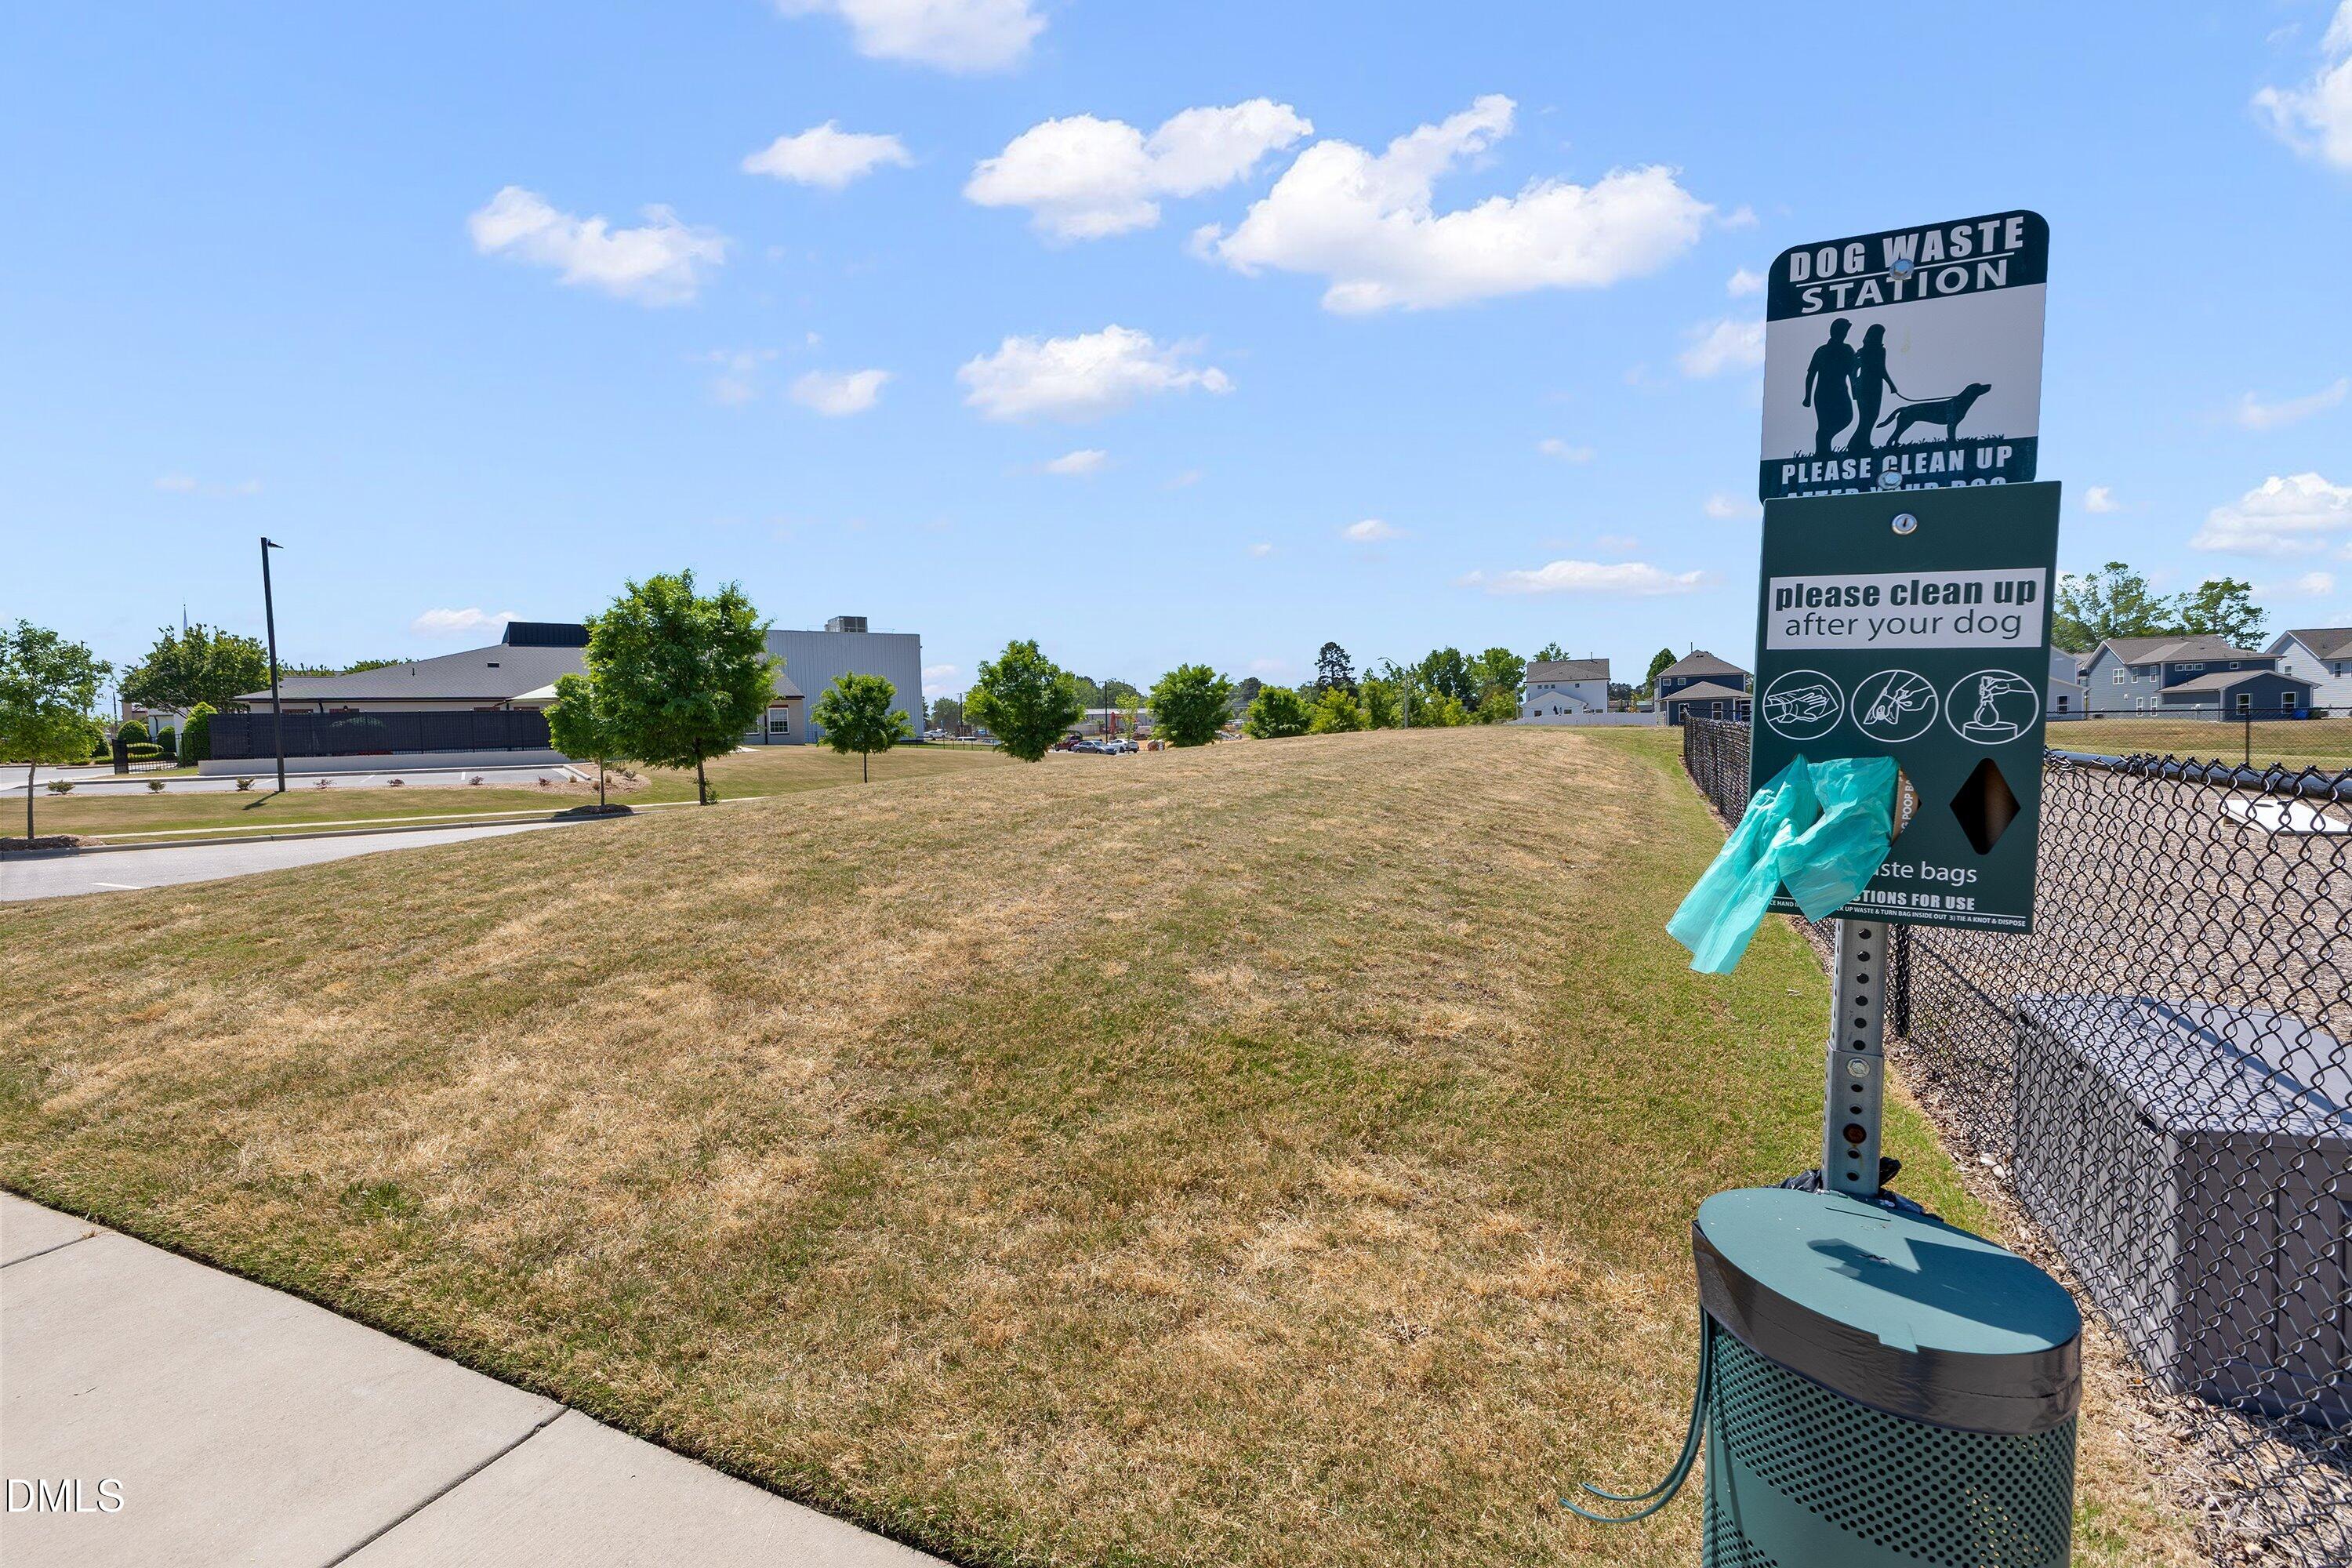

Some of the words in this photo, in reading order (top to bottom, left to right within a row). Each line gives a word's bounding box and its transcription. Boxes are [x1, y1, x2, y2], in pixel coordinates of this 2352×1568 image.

[1789, 241, 1865, 283] DOG
[1883, 216, 2024, 269] WASTE
[1801, 259, 2007, 314] STATION
[1781, 457, 1871, 485] PLEASE
[1882, 449, 1965, 475] CLEAN
[1976, 445, 2013, 469] UP
[1776, 582, 1881, 612] please
[1889, 579, 1982, 606] clean
[1994, 579, 2037, 604] up
[1785, 612, 1858, 636] after
[1868, 617, 1944, 641] your
[1954, 609, 2022, 640] dog
[1902, 793, 1914, 820] POOP
[1875, 862, 1914, 878] ste
[1920, 861, 1977, 887] bags
[1911, 893, 1940, 908] FOR
[1945, 895, 1975, 911] USE
